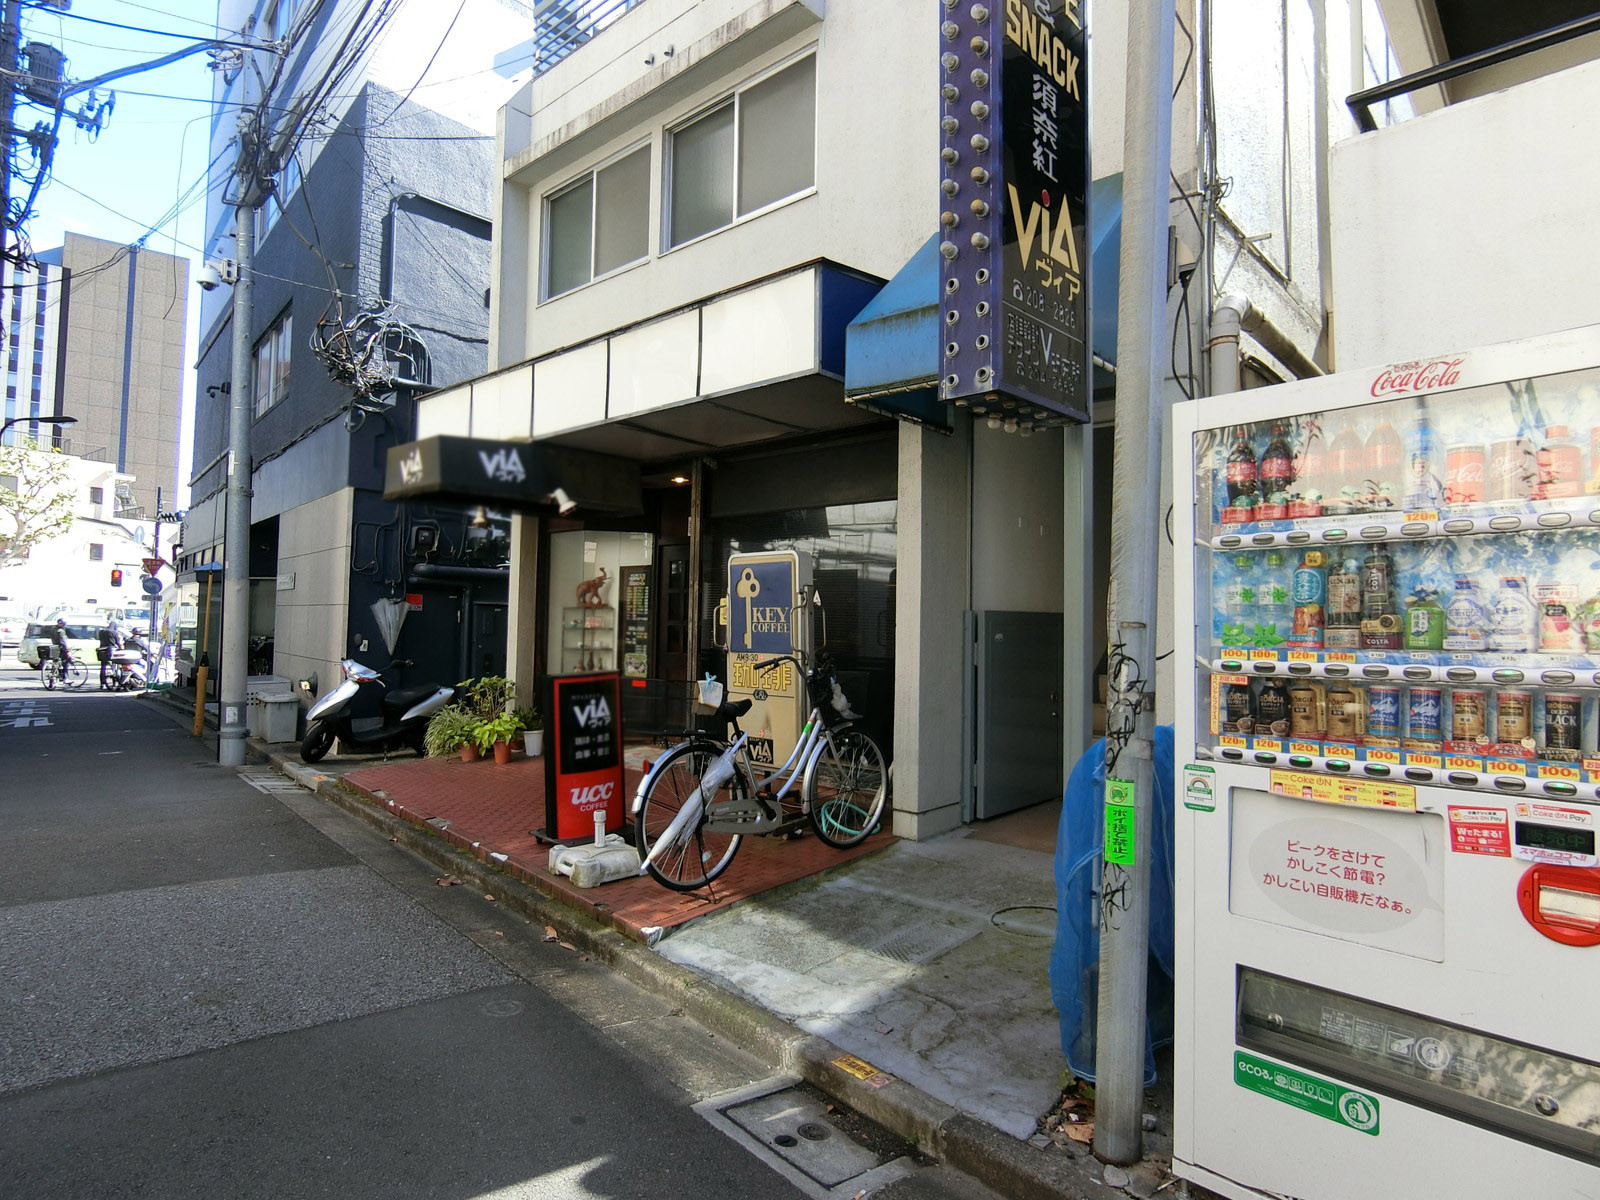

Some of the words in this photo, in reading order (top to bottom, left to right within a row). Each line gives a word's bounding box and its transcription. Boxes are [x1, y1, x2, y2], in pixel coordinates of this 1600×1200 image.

[1006, 0, 1080, 102] SNACK
[1035, 257, 1081, 302] ヴィア
[1370, 358, 1464, 397] Coca-Cola
[752, 607, 789, 623] KEY
[752, 623, 789, 633] COFFEE
[1252, 650, 1276, 658] 100円
[1222, 737, 1244, 746] 120円
[1256, 740, 1279, 748] 120円
[1291, 743, 1317, 752] 120円
[1326, 747, 1353, 756] 120円
[1369, 751, 1399, 760] 100円
[1409, 754, 1439, 764] 100円
[1447, 758, 1480, 768] 100円
[1489, 762, 1523, 772] 100円
[1540, 767, 1577, 777] 100円
[1290, 774, 1314, 785] Coke
[580, 801, 608, 812] COFFEE
[1533, 810, 1553, 818] Coke
[1569, 814, 1586, 823] Pay
[1287, 839, 1386, 869] ピークをさけて
[1286, 856, 1386, 886] かしこく節電?
